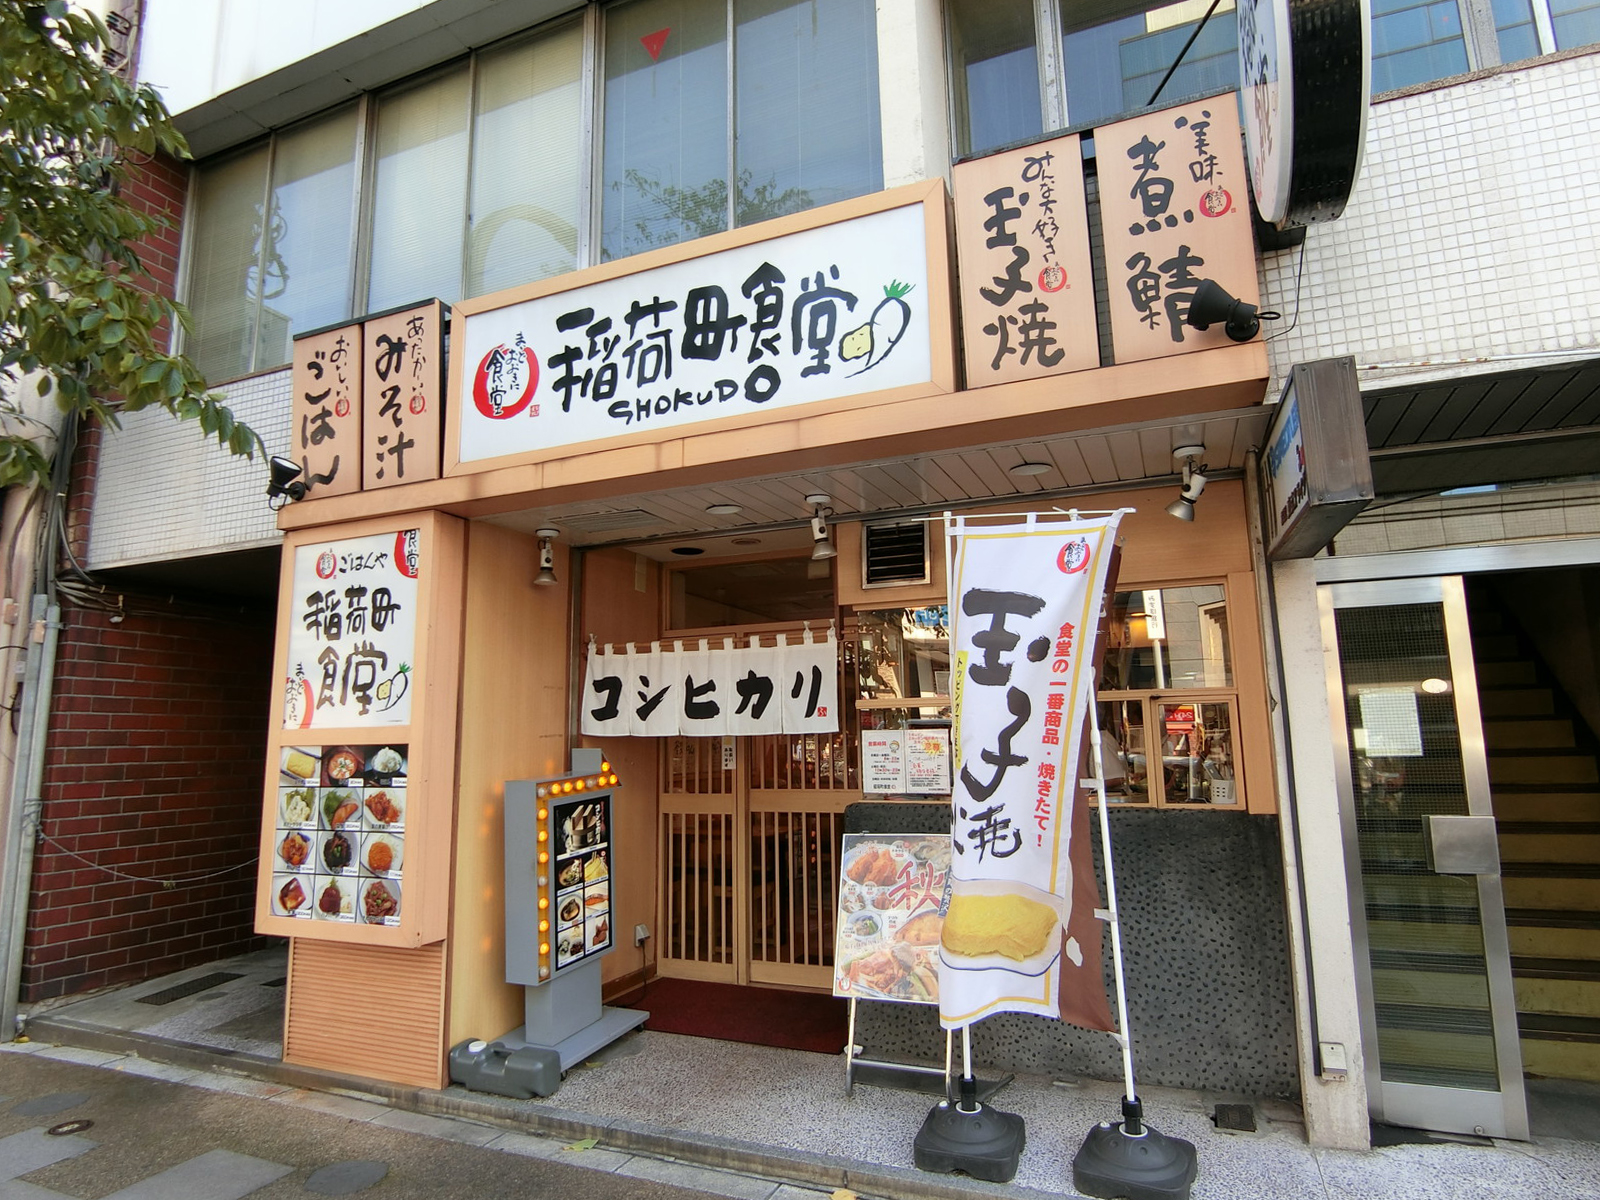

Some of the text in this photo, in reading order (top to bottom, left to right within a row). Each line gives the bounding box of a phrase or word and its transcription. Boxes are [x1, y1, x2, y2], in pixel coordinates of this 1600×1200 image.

[1174, 110, 1223, 185] 美味
[1021, 151, 1060, 264] みんな大好き
[1124, 134, 1207, 343] 煮鯖
[979, 186, 1066, 371] 玉子焼
[330, 334, 350, 398] おいしい
[505, 348, 520, 391] おおきに
[514, 331, 527, 364] まいど
[547, 261, 859, 413] 稲荷町食堂
[375, 333, 415, 480] みそ汁
[485, 349, 507, 415] 食堂
[608, 364, 782, 425] SHOKUDO
[301, 350, 341, 491] ごはん
[339, 551, 389, 574] ごはんや
[303, 584, 402, 642] 稲荷町
[295, 661, 306, 695] まいど
[316, 640, 389, 717] 食堂
[590, 664, 823, 722] コシヒカリ
[954, 586, 1052, 865] 玉子焼
[887, 860, 945, 918] 秋
